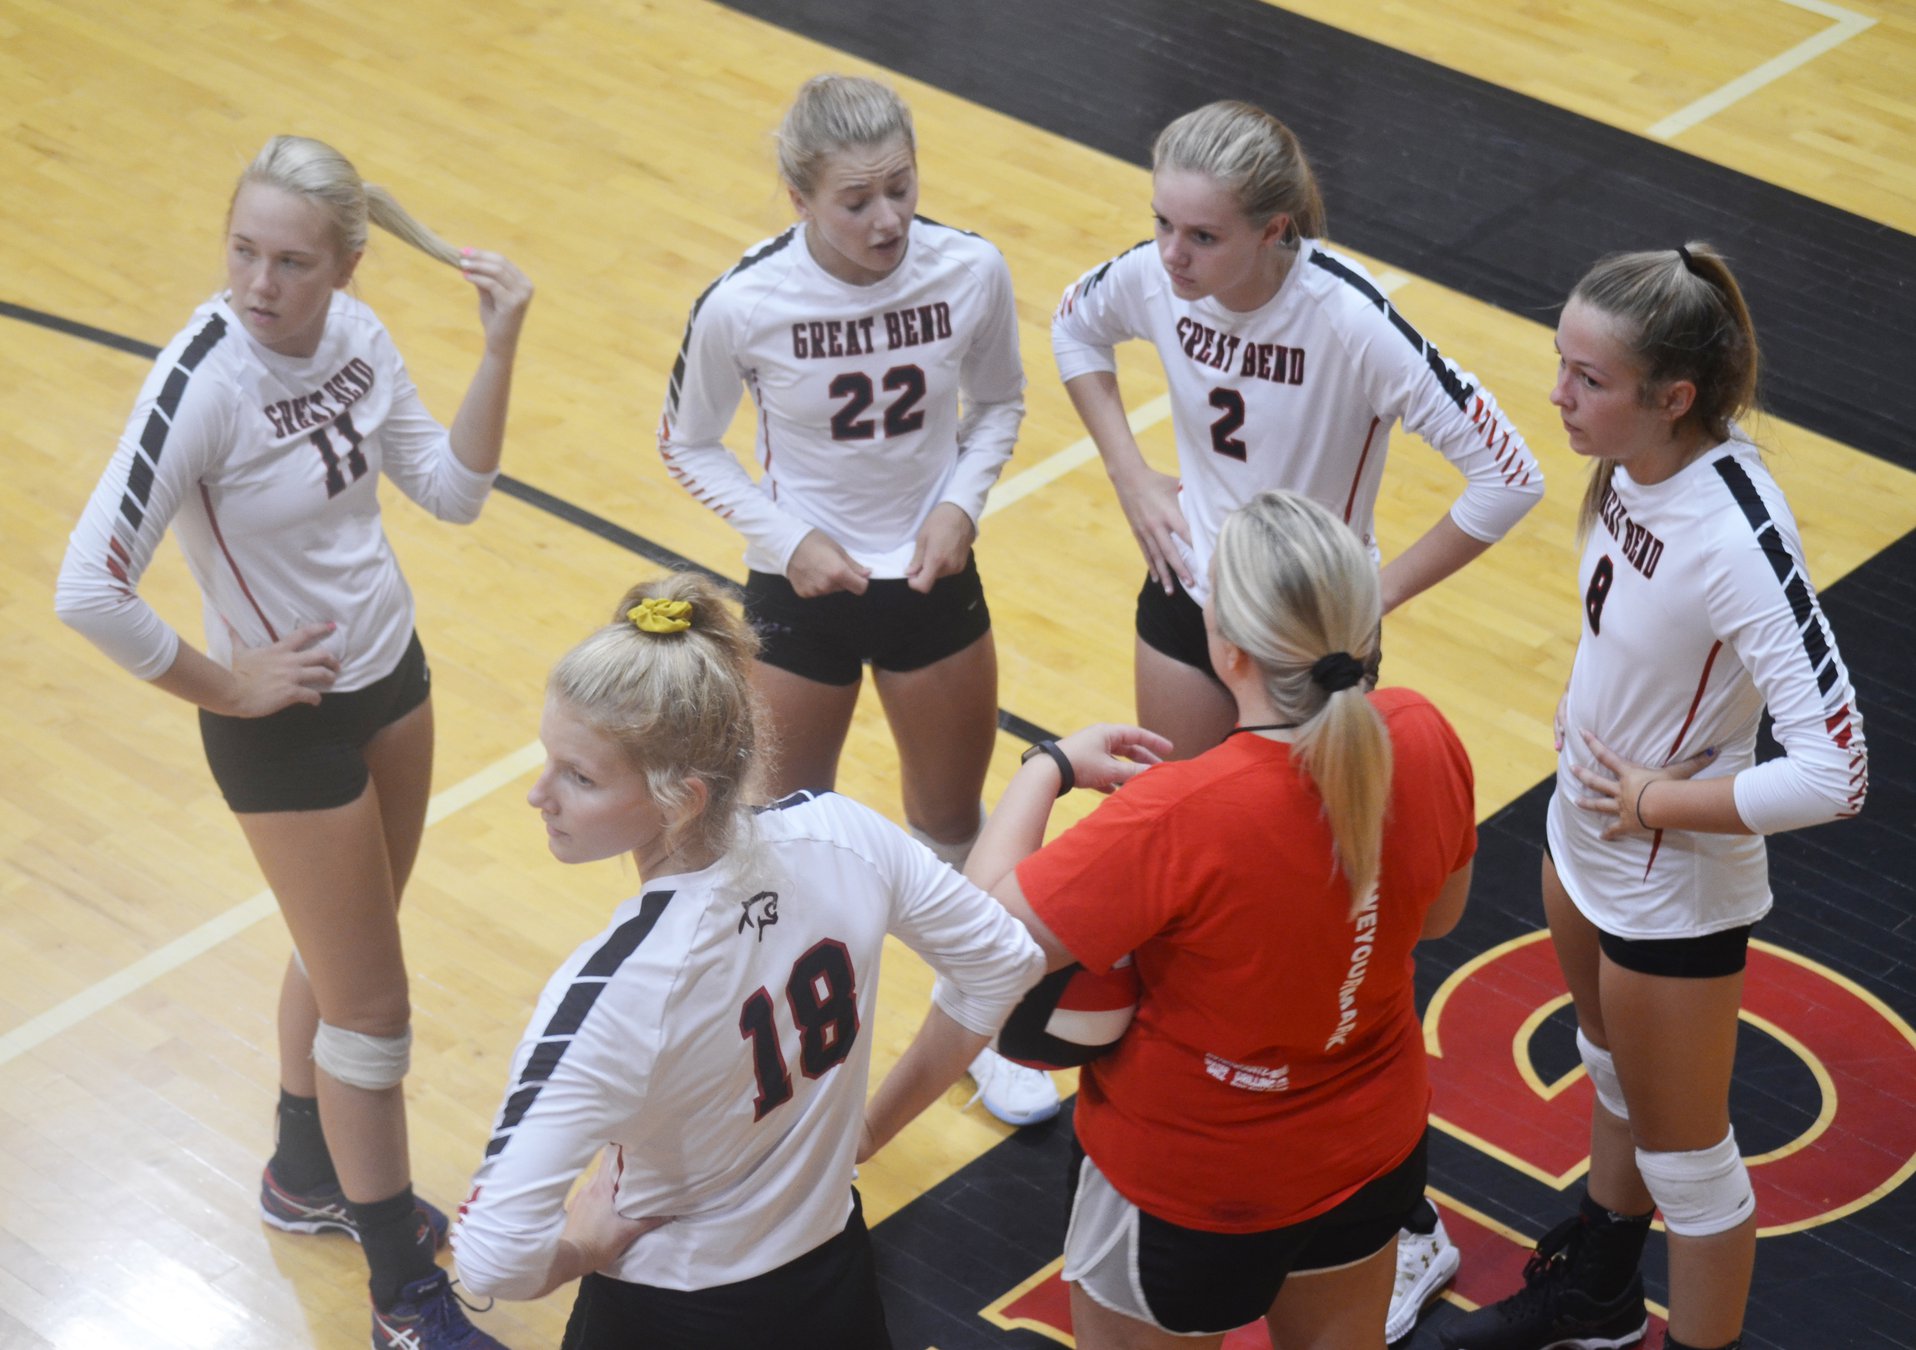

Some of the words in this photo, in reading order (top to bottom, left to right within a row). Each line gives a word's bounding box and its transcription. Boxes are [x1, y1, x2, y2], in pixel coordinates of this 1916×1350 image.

[792, 316, 875, 359] GREAT
[883, 301, 952, 350] BEND
[1240, 341, 1306, 386] BEND
[828, 363, 927, 442] 22
[1208, 386, 1248, 463] 2
[309, 410, 368, 499] 11
[1622, 516, 1665, 580] BEND
[1585, 553, 1614, 637] 8
[738, 936, 861, 1123] 18
